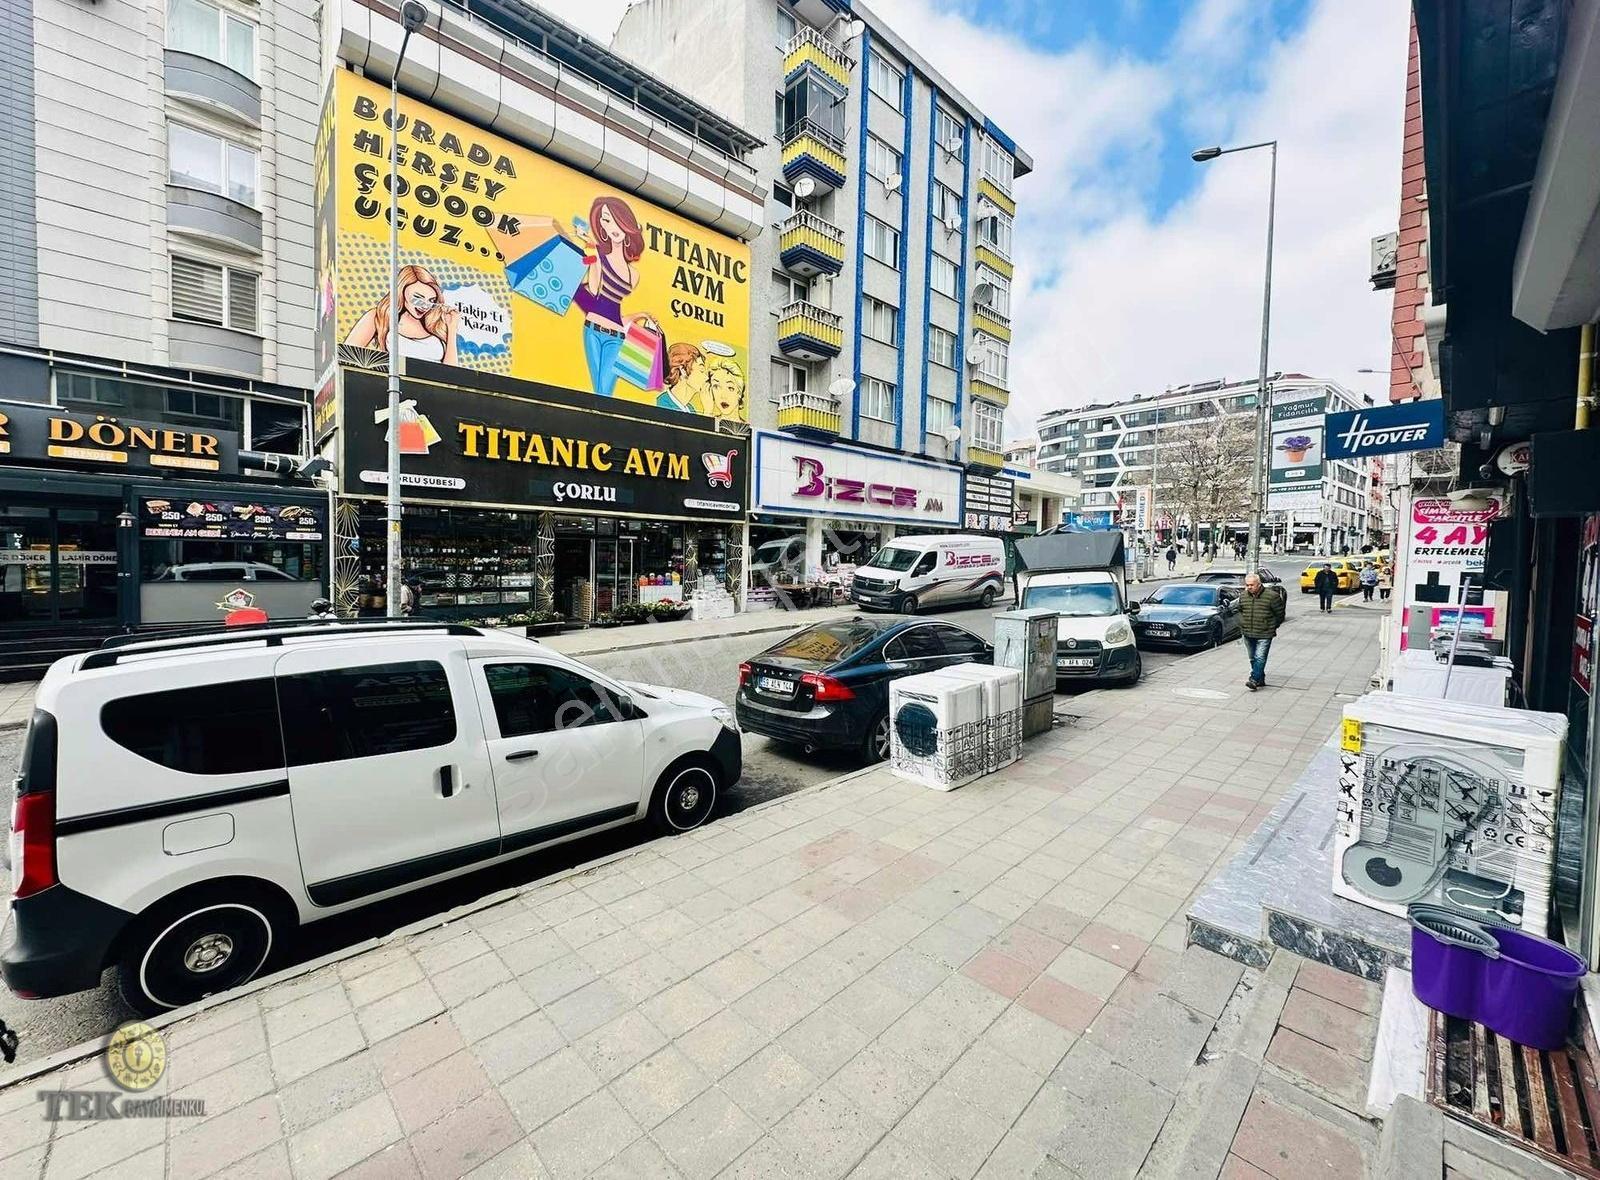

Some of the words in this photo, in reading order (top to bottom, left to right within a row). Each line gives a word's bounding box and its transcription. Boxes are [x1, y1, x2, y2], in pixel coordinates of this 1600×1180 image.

[353, 95, 517, 178] BURADA
[353, 129, 506, 201] HERŞEY
[646, 222, 747, 284] TITANIC
[672, 265, 725, 305] AVM
[454, 302, 487, 320] Takip
[461, 316, 498, 334] Kazan
[670, 298, 724, 328] ÇORLU
[48, 414, 220, 456] DÖNER
[457, 422, 613, 471] TITANIC
[623, 447, 691, 482] AVM
[423, 477, 456, 487] ŞUBESİ
[552, 481, 617, 503] ÇORLU
[1414, 526, 1438, 544] 4
[1443, 526, 1488, 544] AY
